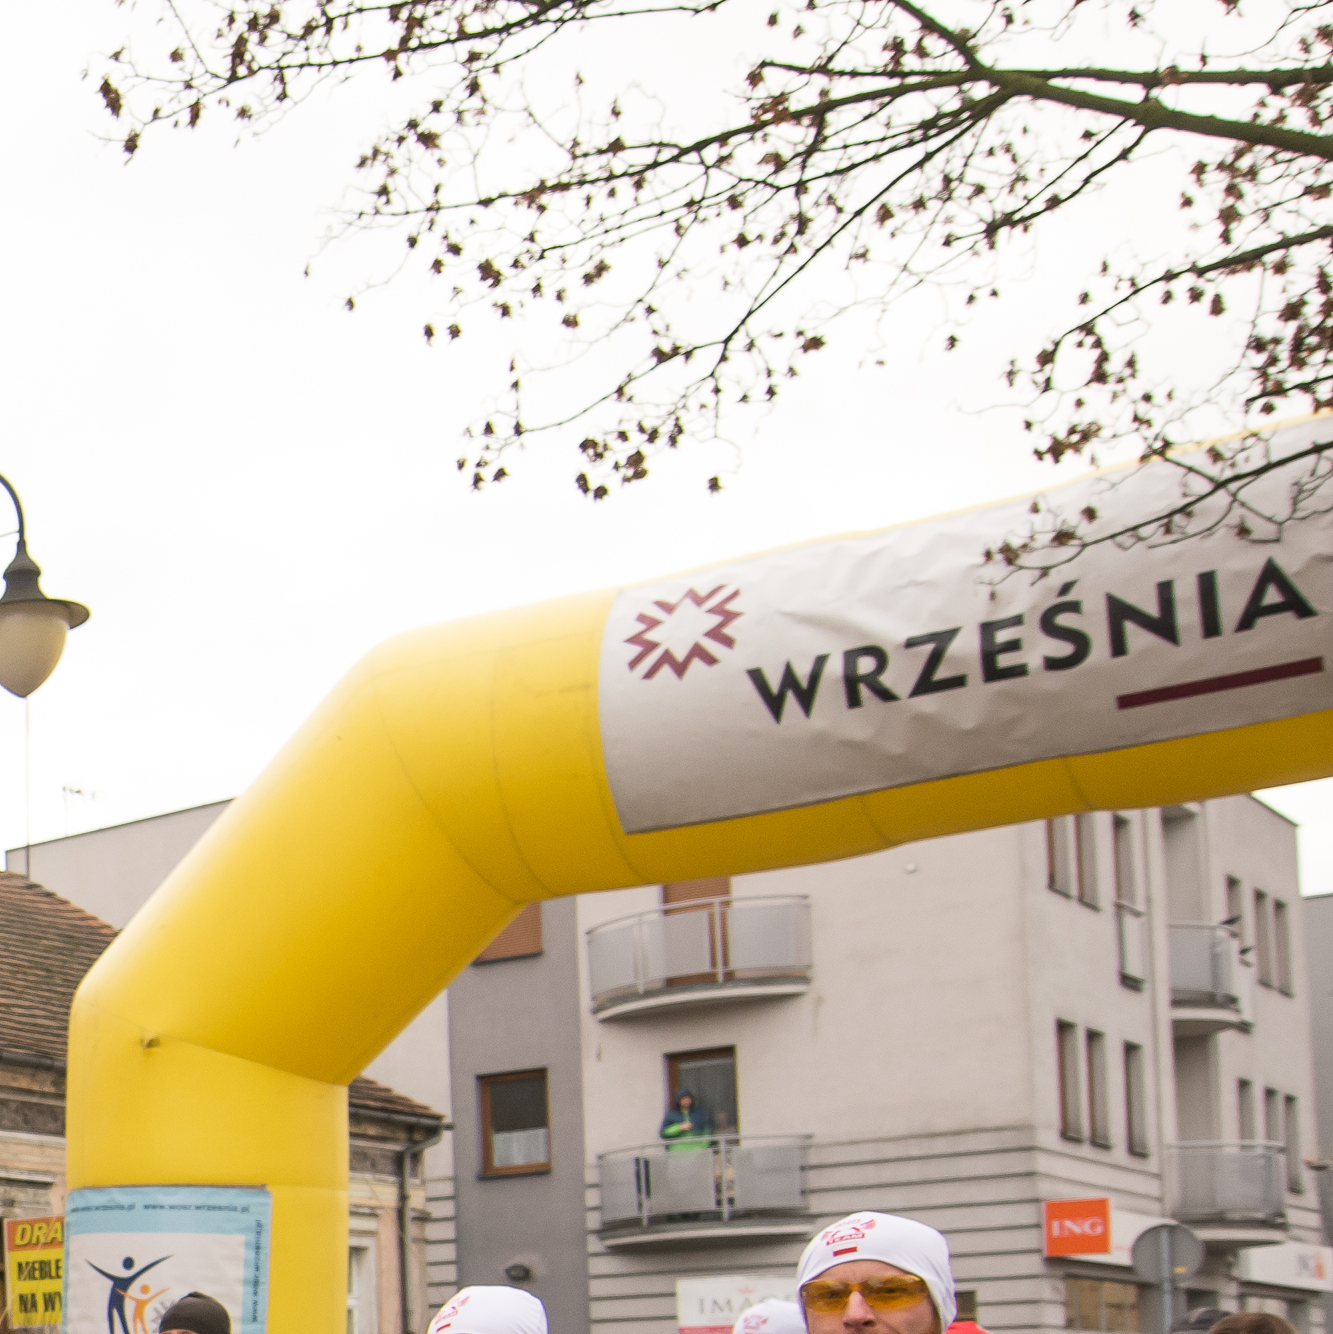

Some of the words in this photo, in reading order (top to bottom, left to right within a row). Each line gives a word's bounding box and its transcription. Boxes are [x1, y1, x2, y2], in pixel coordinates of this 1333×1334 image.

[747, 557, 1318, 725] WRZEŚNIA
[1051, 1217, 1104, 1238] ING
[19, 1292, 38, 1314] NA
